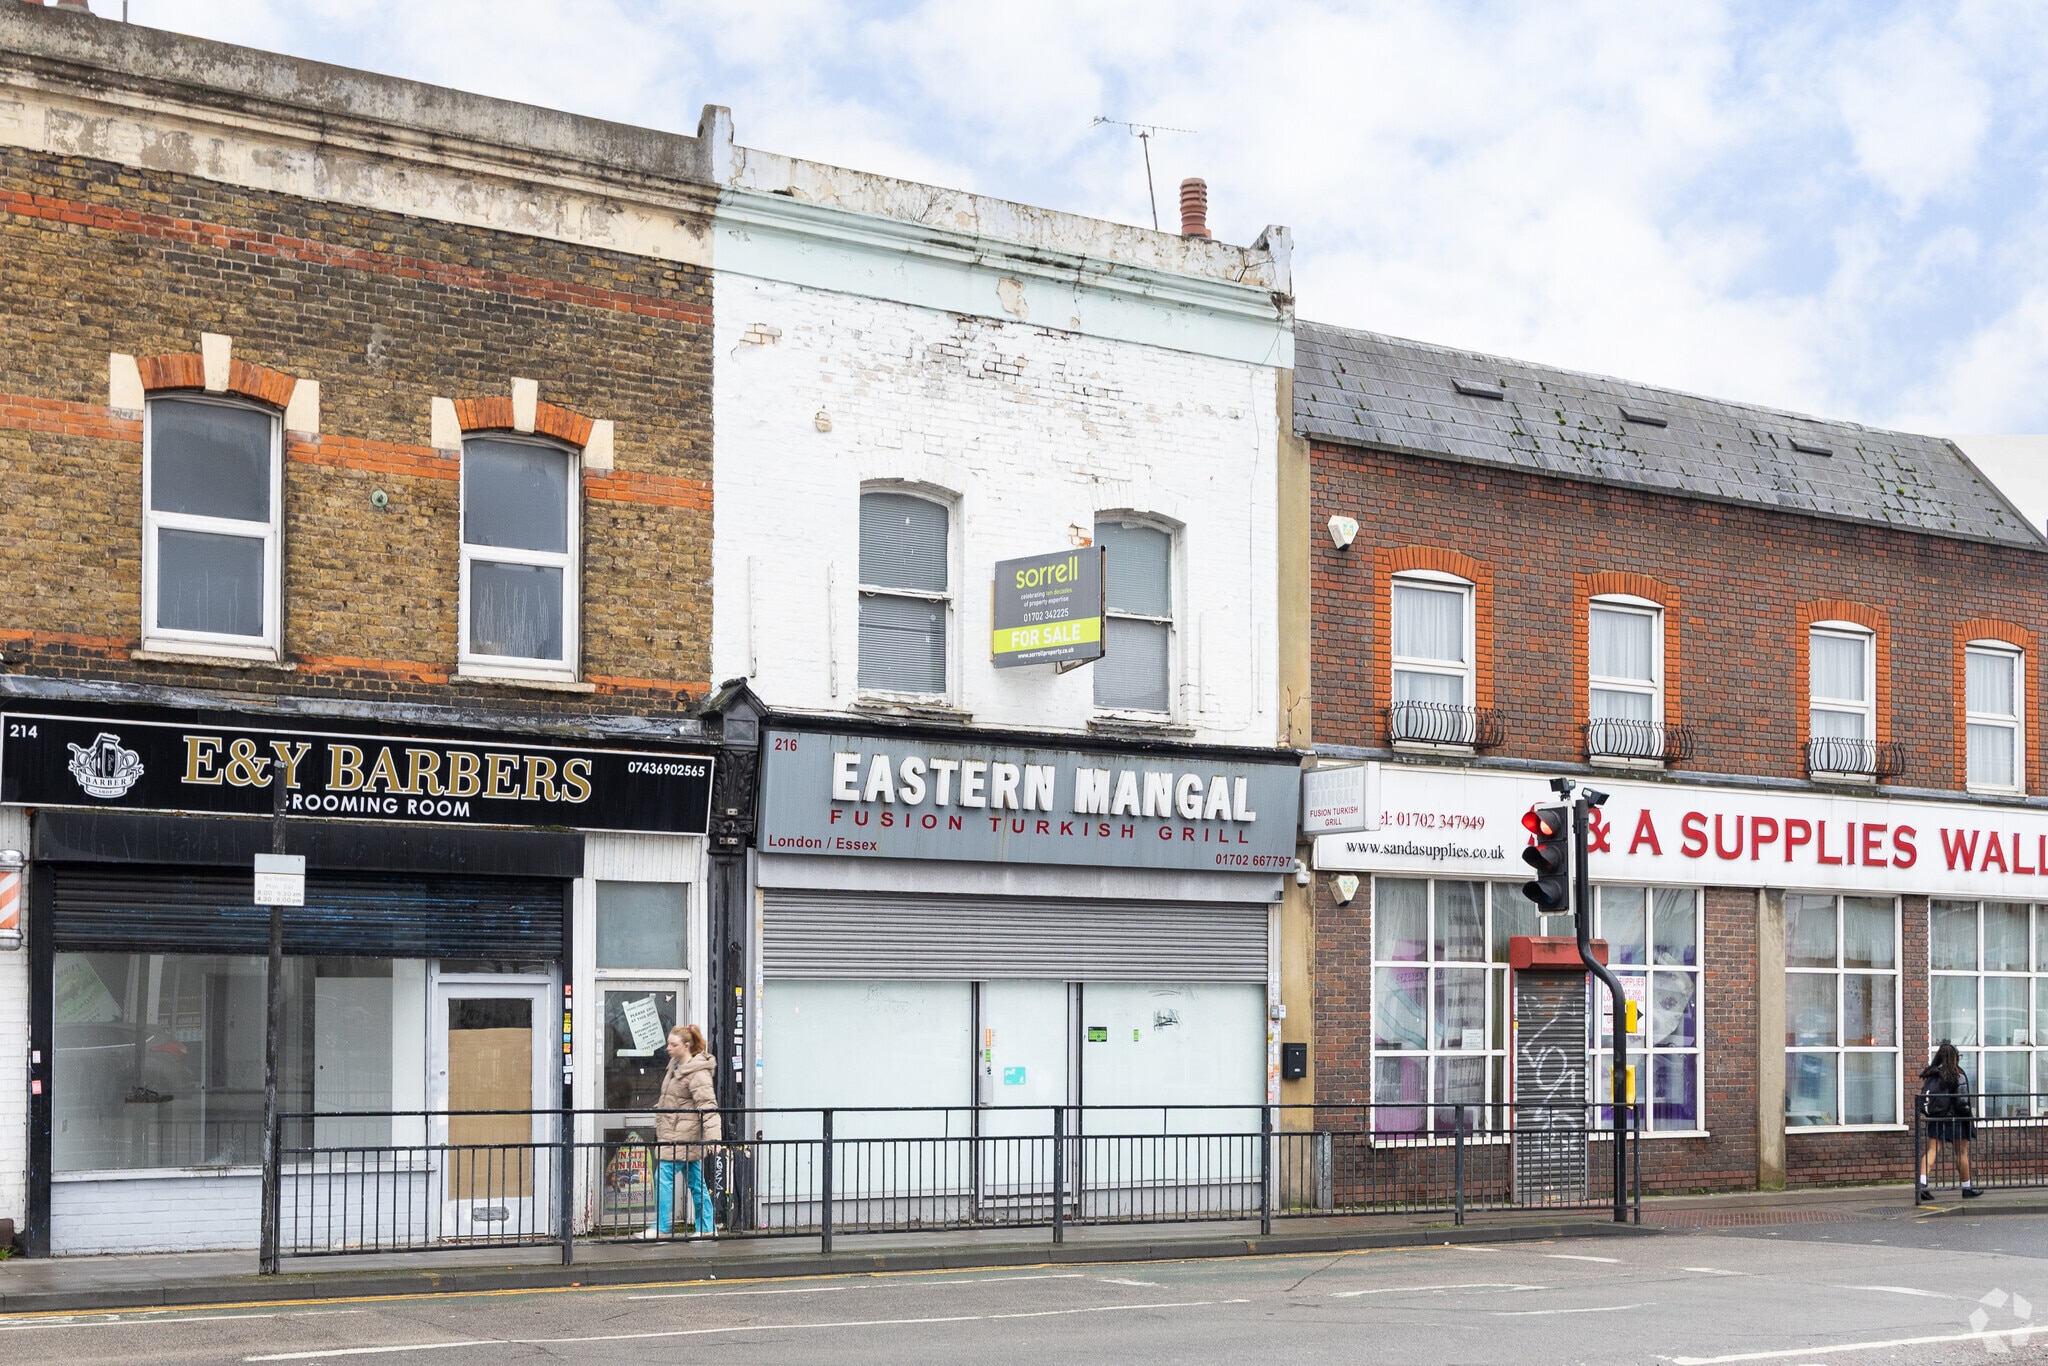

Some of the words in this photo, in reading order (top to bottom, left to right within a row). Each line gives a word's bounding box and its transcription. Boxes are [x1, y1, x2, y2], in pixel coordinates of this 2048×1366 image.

[1015, 555, 1078, 589] sorrell
[1020, 591, 1045, 600] celebrating
[1029, 599, 1047, 608] property
[1048, 596, 1069, 604] expertise
[1023, 611, 1043, 623] 01702
[1045, 608, 1069, 620] 342225
[1011, 629, 1040, 649] FOR
[1043, 623, 1081, 645] SALE
[10, 724, 38, 739] 214
[775, 738, 798, 752] 216
[181, 735, 312, 789] E&Y
[325, 743, 593, 804] BARBERS
[628, 762, 705, 777] 07436902565
[86, 776, 126, 786] BARBER
[832, 752, 1056, 811] EASTERN
[1074, 766, 1257, 822] MANGAL
[286, 793, 398, 815] ROOMING
[407, 799, 470, 818] ROOM
[1310, 808, 1331, 818] FUSION
[1333, 806, 1358, 815] TURKISH
[830, 809, 963, 831] FUSION
[989, 817, 1134, 839] TURKISH
[1158, 826, 1249, 844] GRILL
[1325, 818, 1342, 826] GRILL
[1381, 810, 1393, 826] el:
[1397, 811, 1435, 829] 01702
[1439, 814, 1485, 830] 347949
[769, 834, 822, 849] London
[836, 837, 877, 851] Essex
[1628, 808, 1663, 856] A
[1681, 811, 1917, 870] SUPPLIES
[1346, 841, 1505, 860] www.sandasupplies.co.uk
[1215, 853, 1249, 866] 01702
[1252, 855, 1292, 868] 667797
